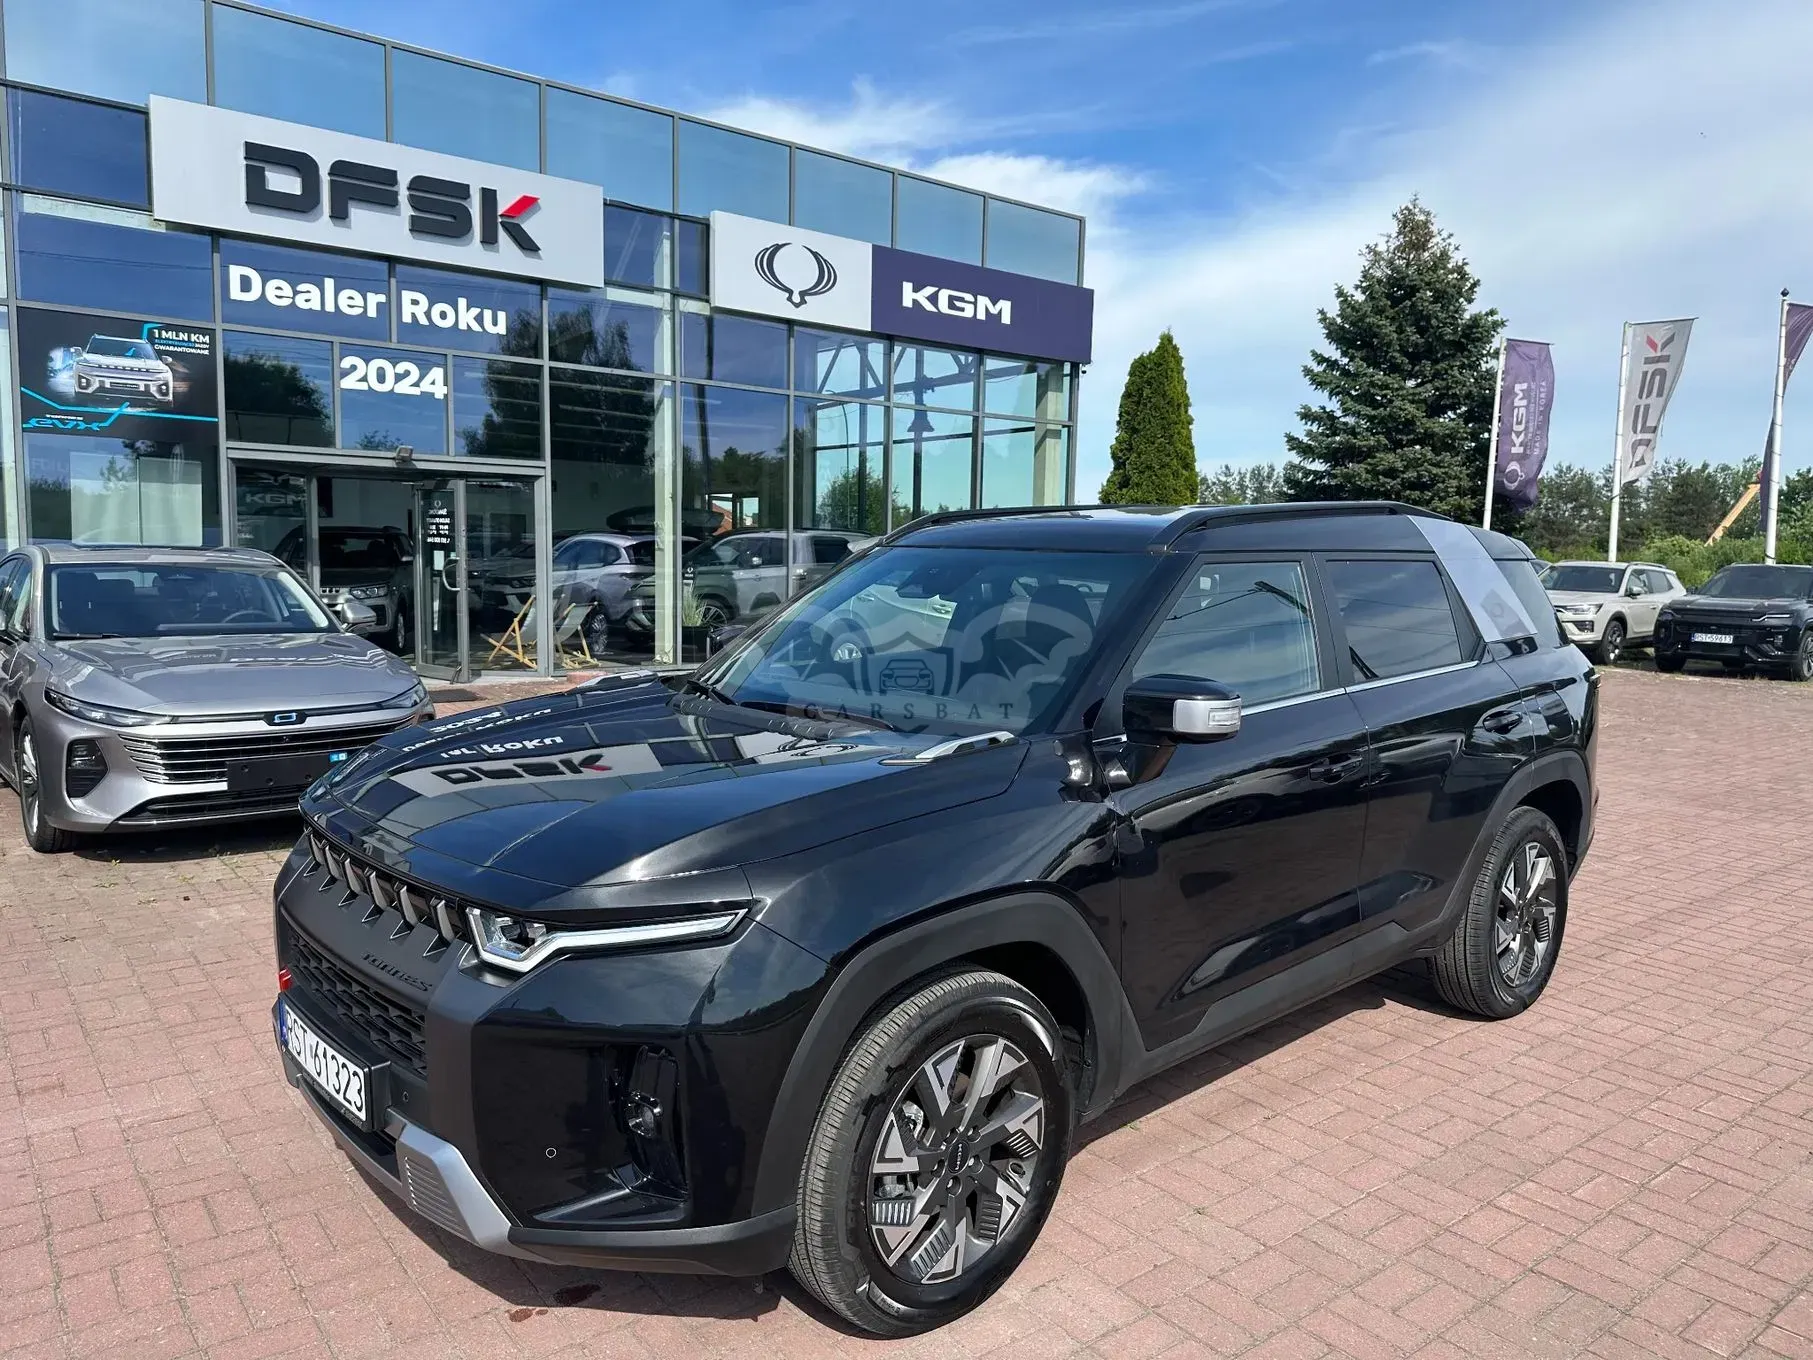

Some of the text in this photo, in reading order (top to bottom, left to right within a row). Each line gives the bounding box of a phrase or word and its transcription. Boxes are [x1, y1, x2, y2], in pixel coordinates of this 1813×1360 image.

[243, 140, 541, 251] DFSK
[228, 264, 508, 335] Dealer Roku
[902, 281, 1012, 325] KGM
[153, 329, 210, 344] 1 MLN KM
[340, 356, 448, 399] 2024
[1630, 331, 1676, 469] DFSK
[1510, 382, 1528, 454] KGM
[286, 1010, 308, 1067] RST
[313, 1039, 365, 1113] 61323
